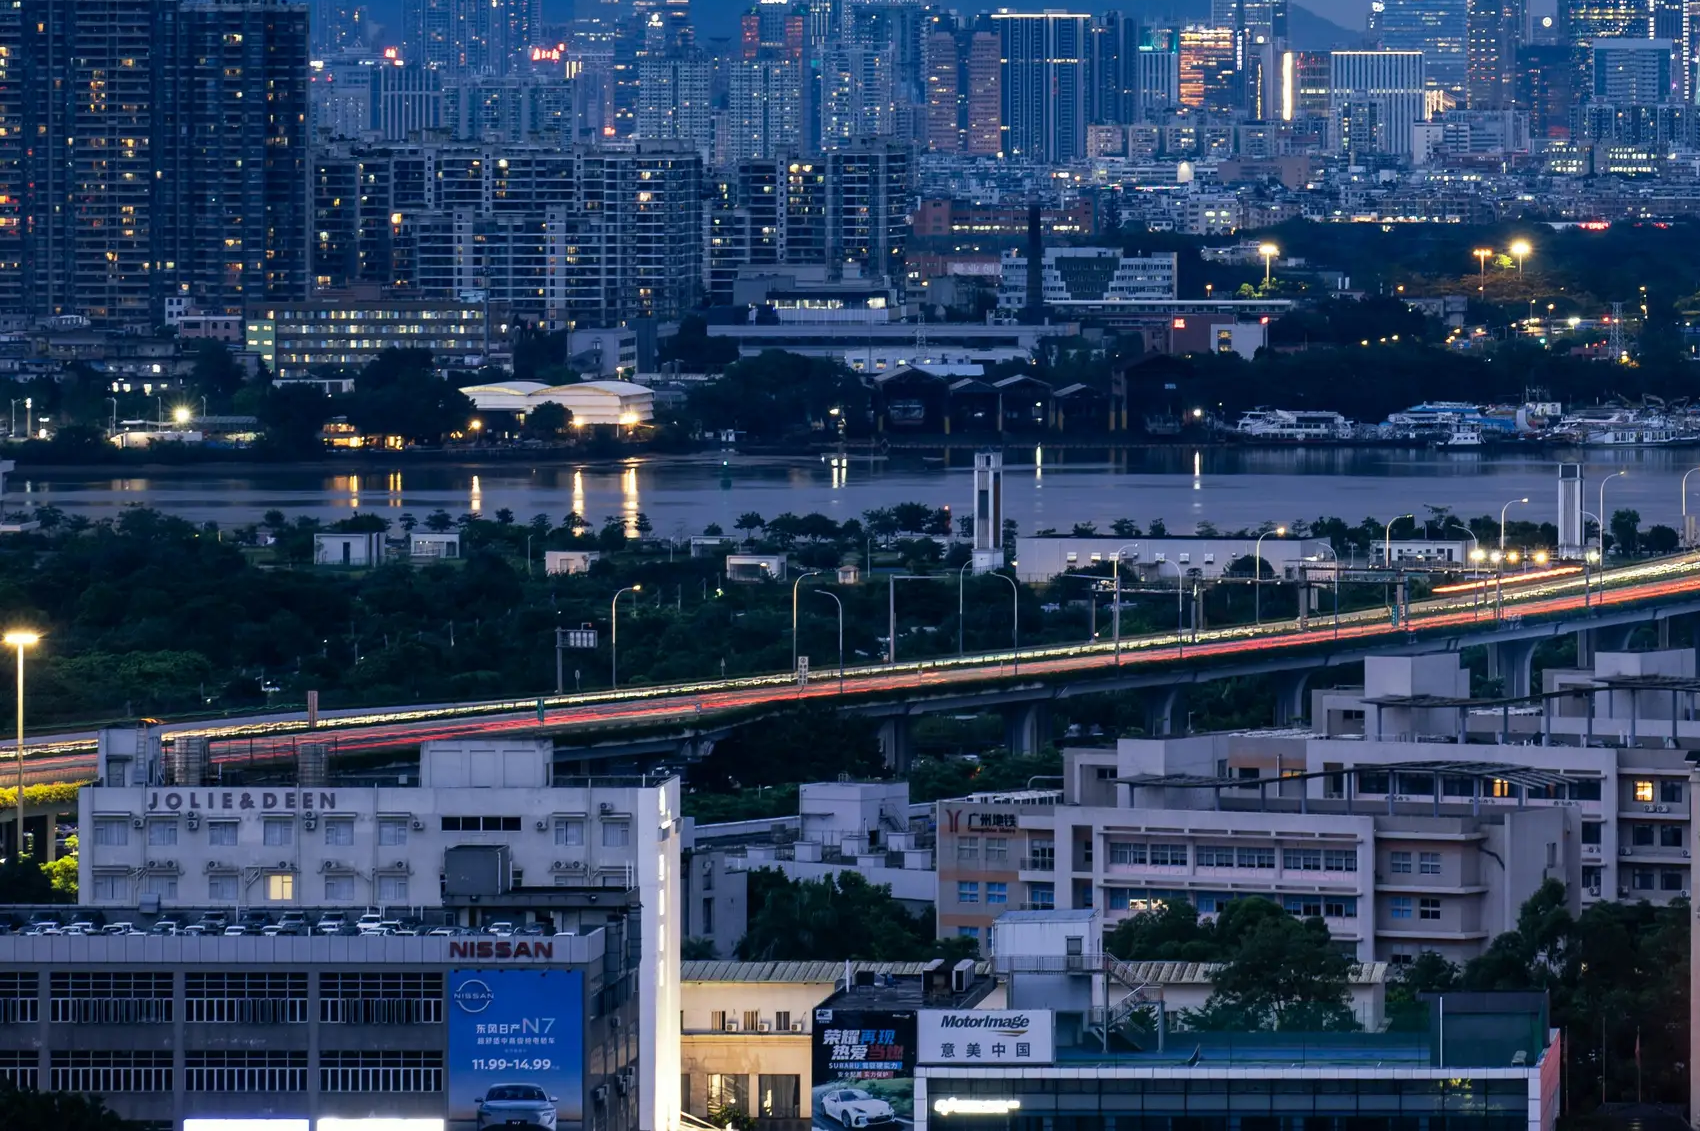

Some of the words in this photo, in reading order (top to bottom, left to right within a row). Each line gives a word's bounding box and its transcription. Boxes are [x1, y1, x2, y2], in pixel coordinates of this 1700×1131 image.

[148, 792, 336, 810] JOLIE&DEEN
[968, 813, 1016, 827] 广州地铁
[449, 941, 553, 958] NISSAN
[940, 1014, 1030, 1029] MotorImage
[822, 1028, 897, 1045] 荣耀再现
[831, 1044, 905, 1061] 热爱当燃
[940, 1042, 1031, 1058] 意美中国
[471, 1058, 551, 1070] 11.99-14.99
